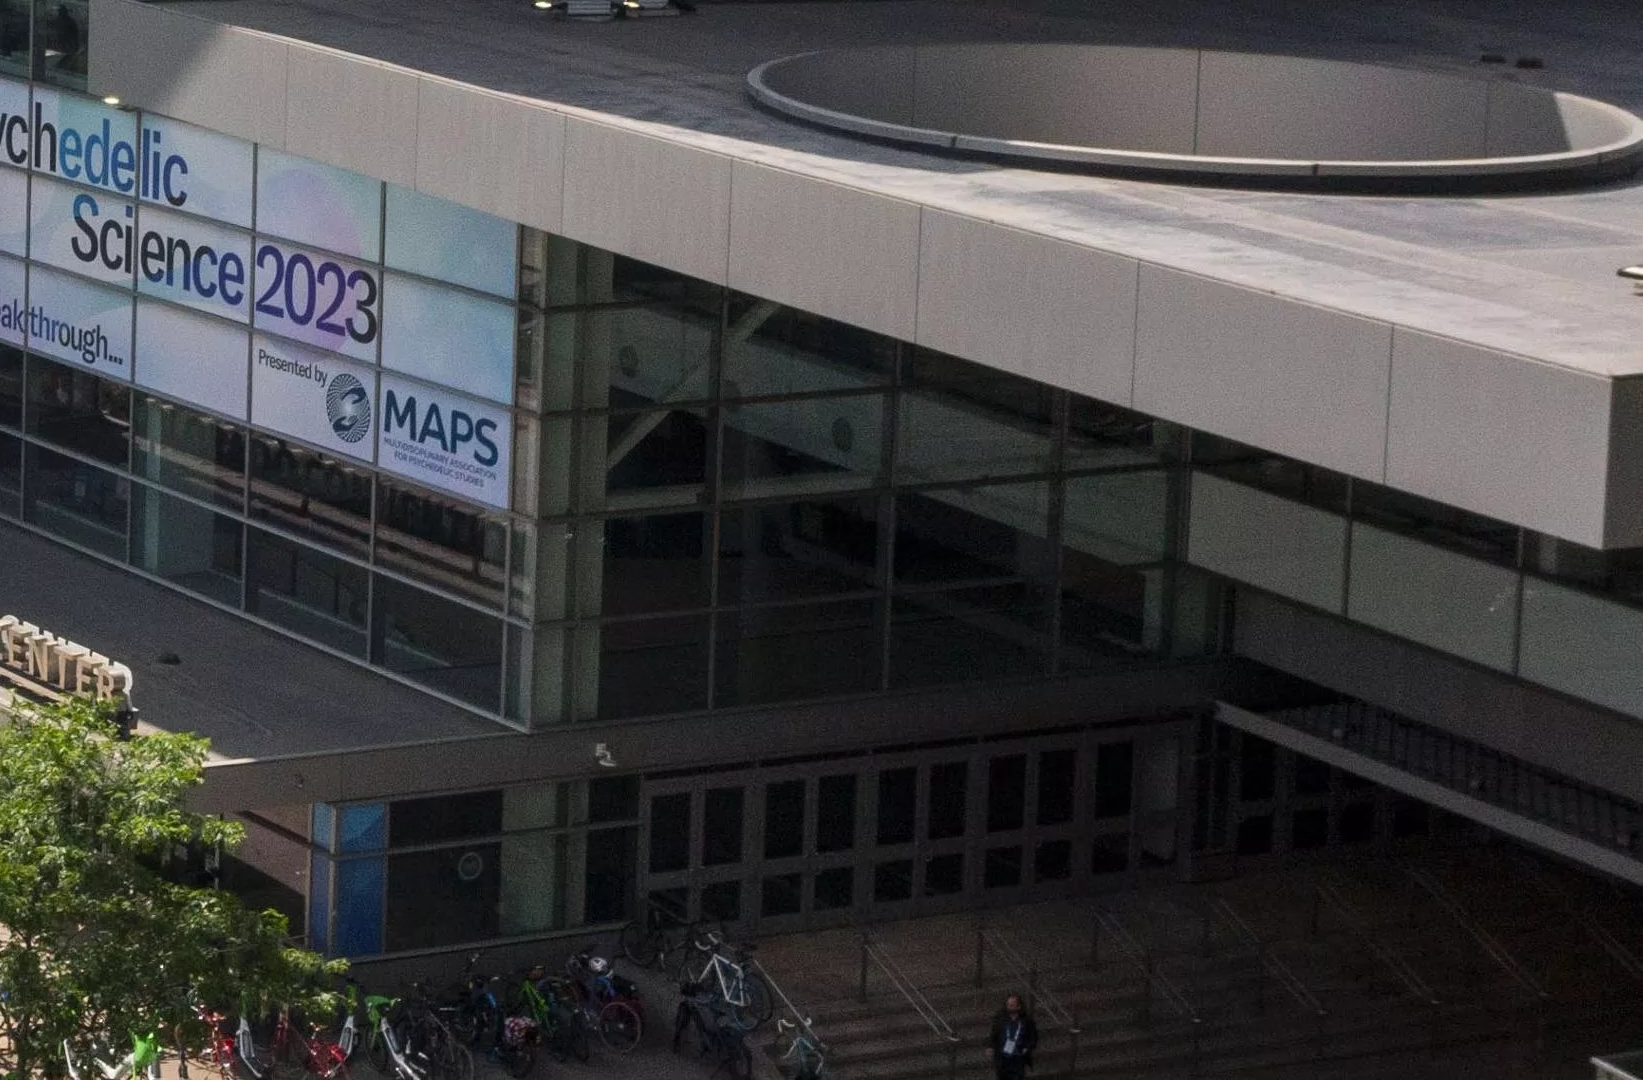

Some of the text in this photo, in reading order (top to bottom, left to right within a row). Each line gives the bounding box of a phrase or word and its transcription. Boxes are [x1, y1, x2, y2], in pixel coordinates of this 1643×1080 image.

[71, 193, 377, 344] Science 2023
[258, 348, 328, 388] Presented by
[384, 389, 499, 467] MAPS
